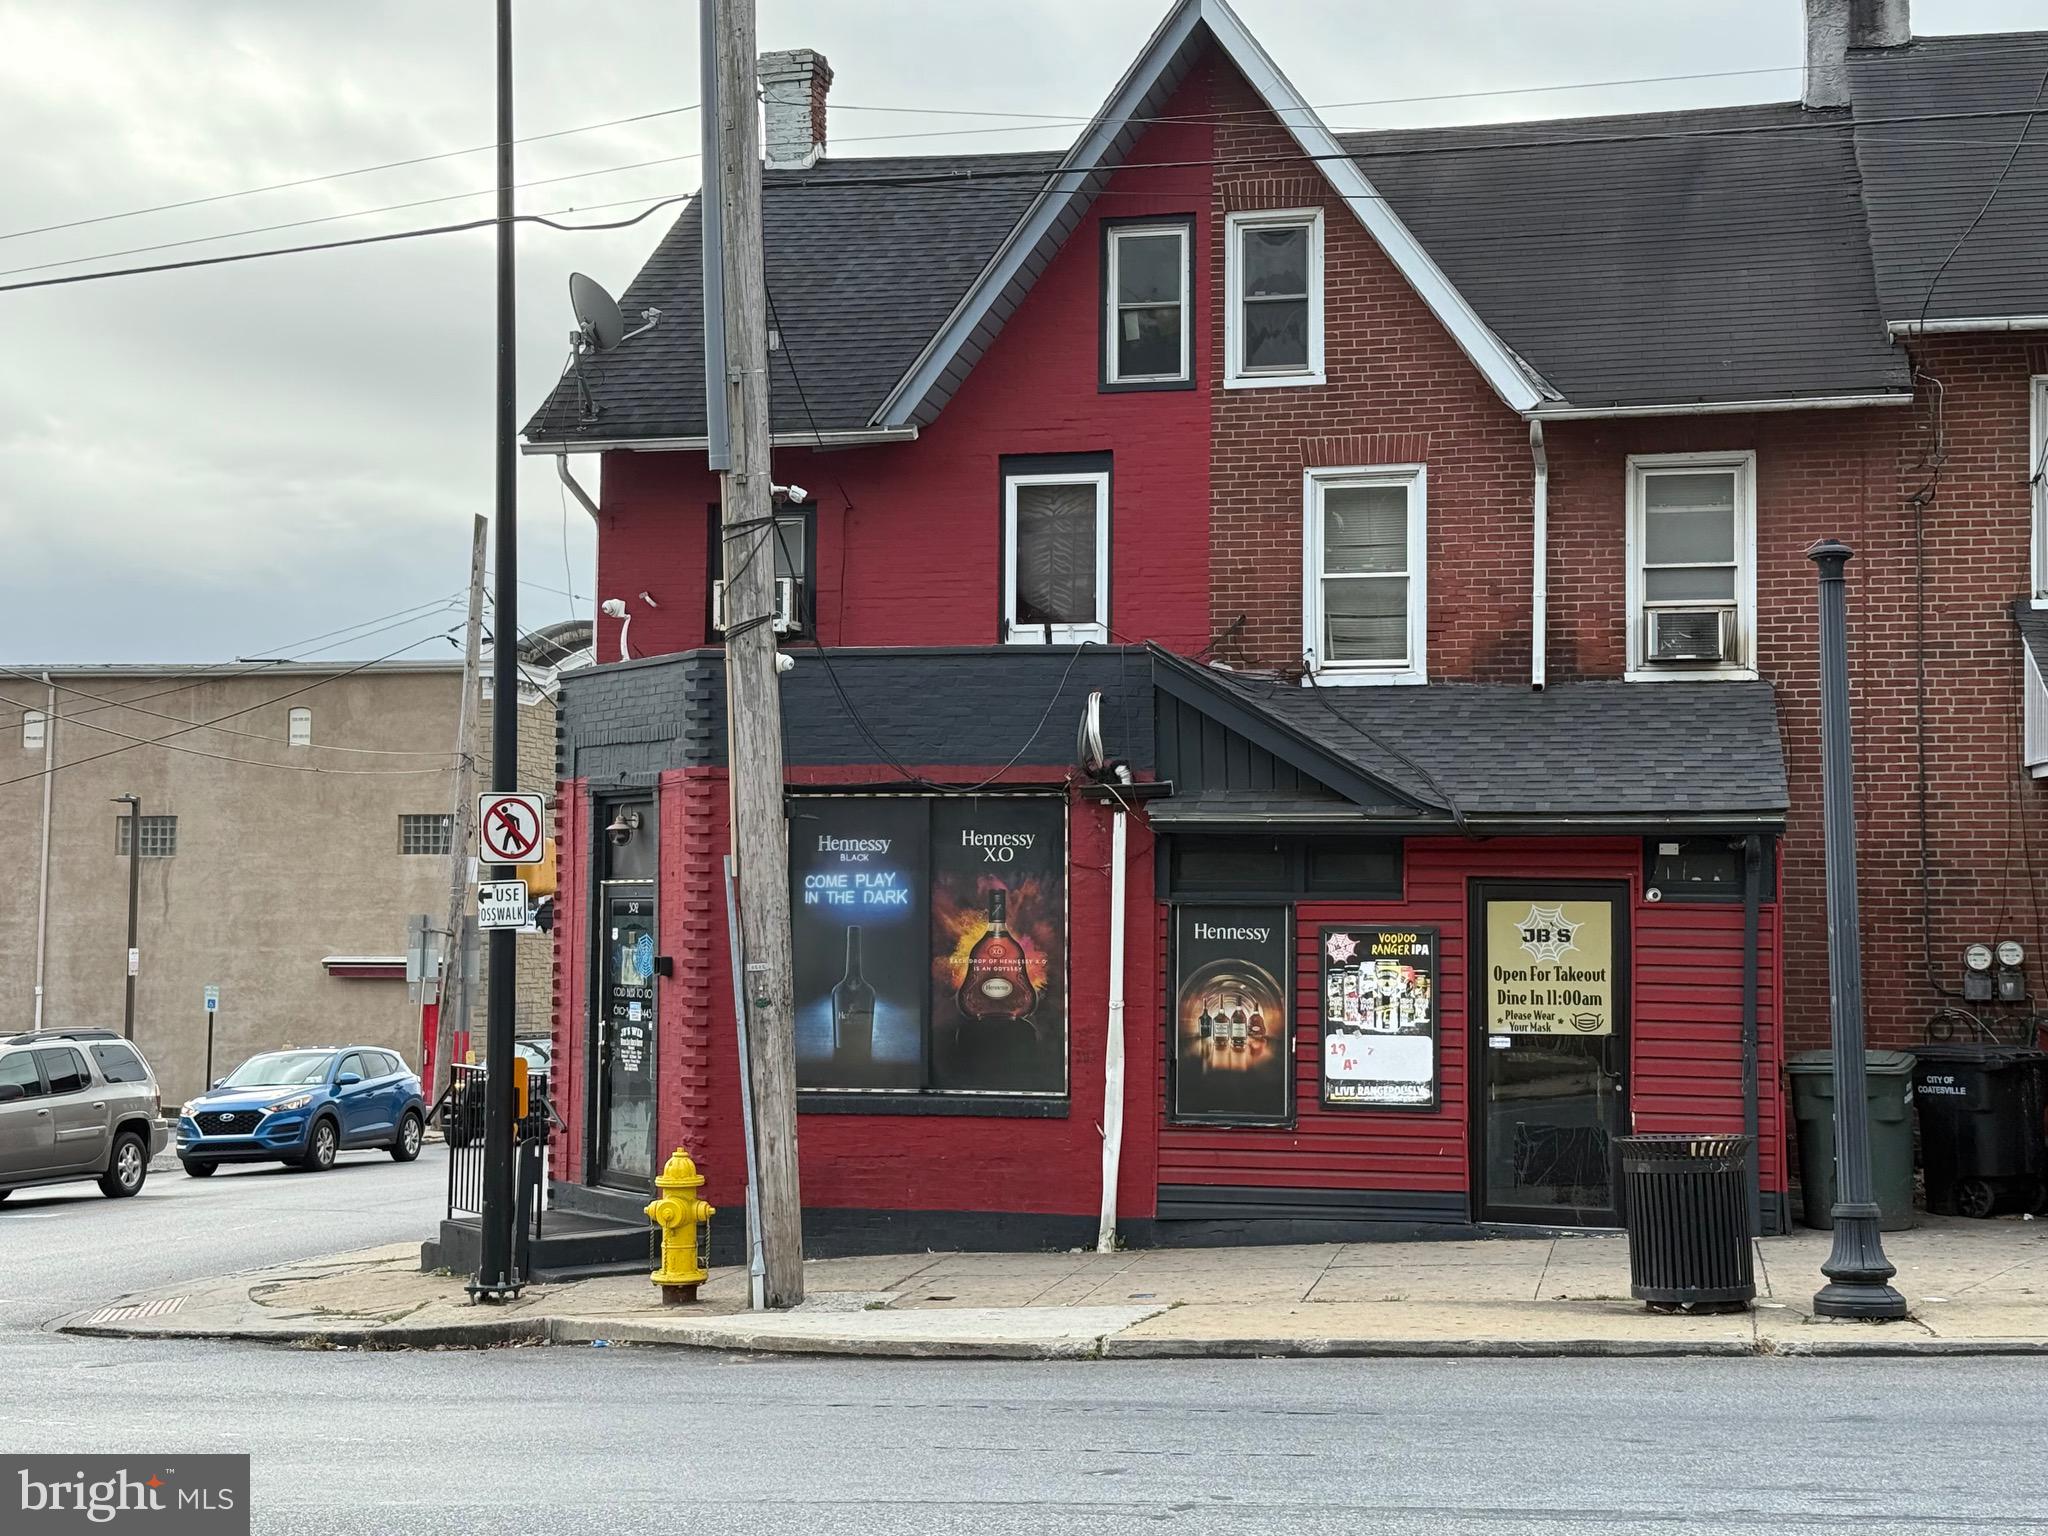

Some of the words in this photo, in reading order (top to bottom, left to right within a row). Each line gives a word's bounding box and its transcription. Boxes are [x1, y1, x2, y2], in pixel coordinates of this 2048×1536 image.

[818, 835, 892, 854] Hennessy
[962, 830, 1035, 849] Hennessy
[984, 847, 1014, 862] X.O
[805, 874, 848, 888] COME
[855, 872, 896, 888] PLAY
[496, 888, 520, 901] USE
[805, 891, 818, 904] IN
[826, 891, 855, 904] THE
[864, 889, 908, 904] DARK
[1194, 923, 1270, 943] Hennessy
[1378, 933, 1417, 943] VOODOO
[1371, 944, 1411, 955] RANGER
[1411, 944, 1429, 955] IPA
[1493, 965, 1527, 984] Open
[1530, 966, 1551, 981] For
[1553, 965, 1606, 982] Takeout
[1497, 989, 1527, 1005] Dine
[1530, 989, 1544, 1005] In
[1547, 989, 1602, 1006] 11:00am
[1505, 1009, 1531, 1020] Please
[1533, 1010, 1555, 1020] Wear
[1509, 1022, 1528, 1032] Your
[1529, 1022, 1551, 1032] Mask
[1926, 1075, 1942, 1084] CITY
[1943, 1076, 1954, 1084] OF
[1334, 1085, 1355, 1096] LIVE
[1917, 1085, 1967, 1095] COATESVILLE
